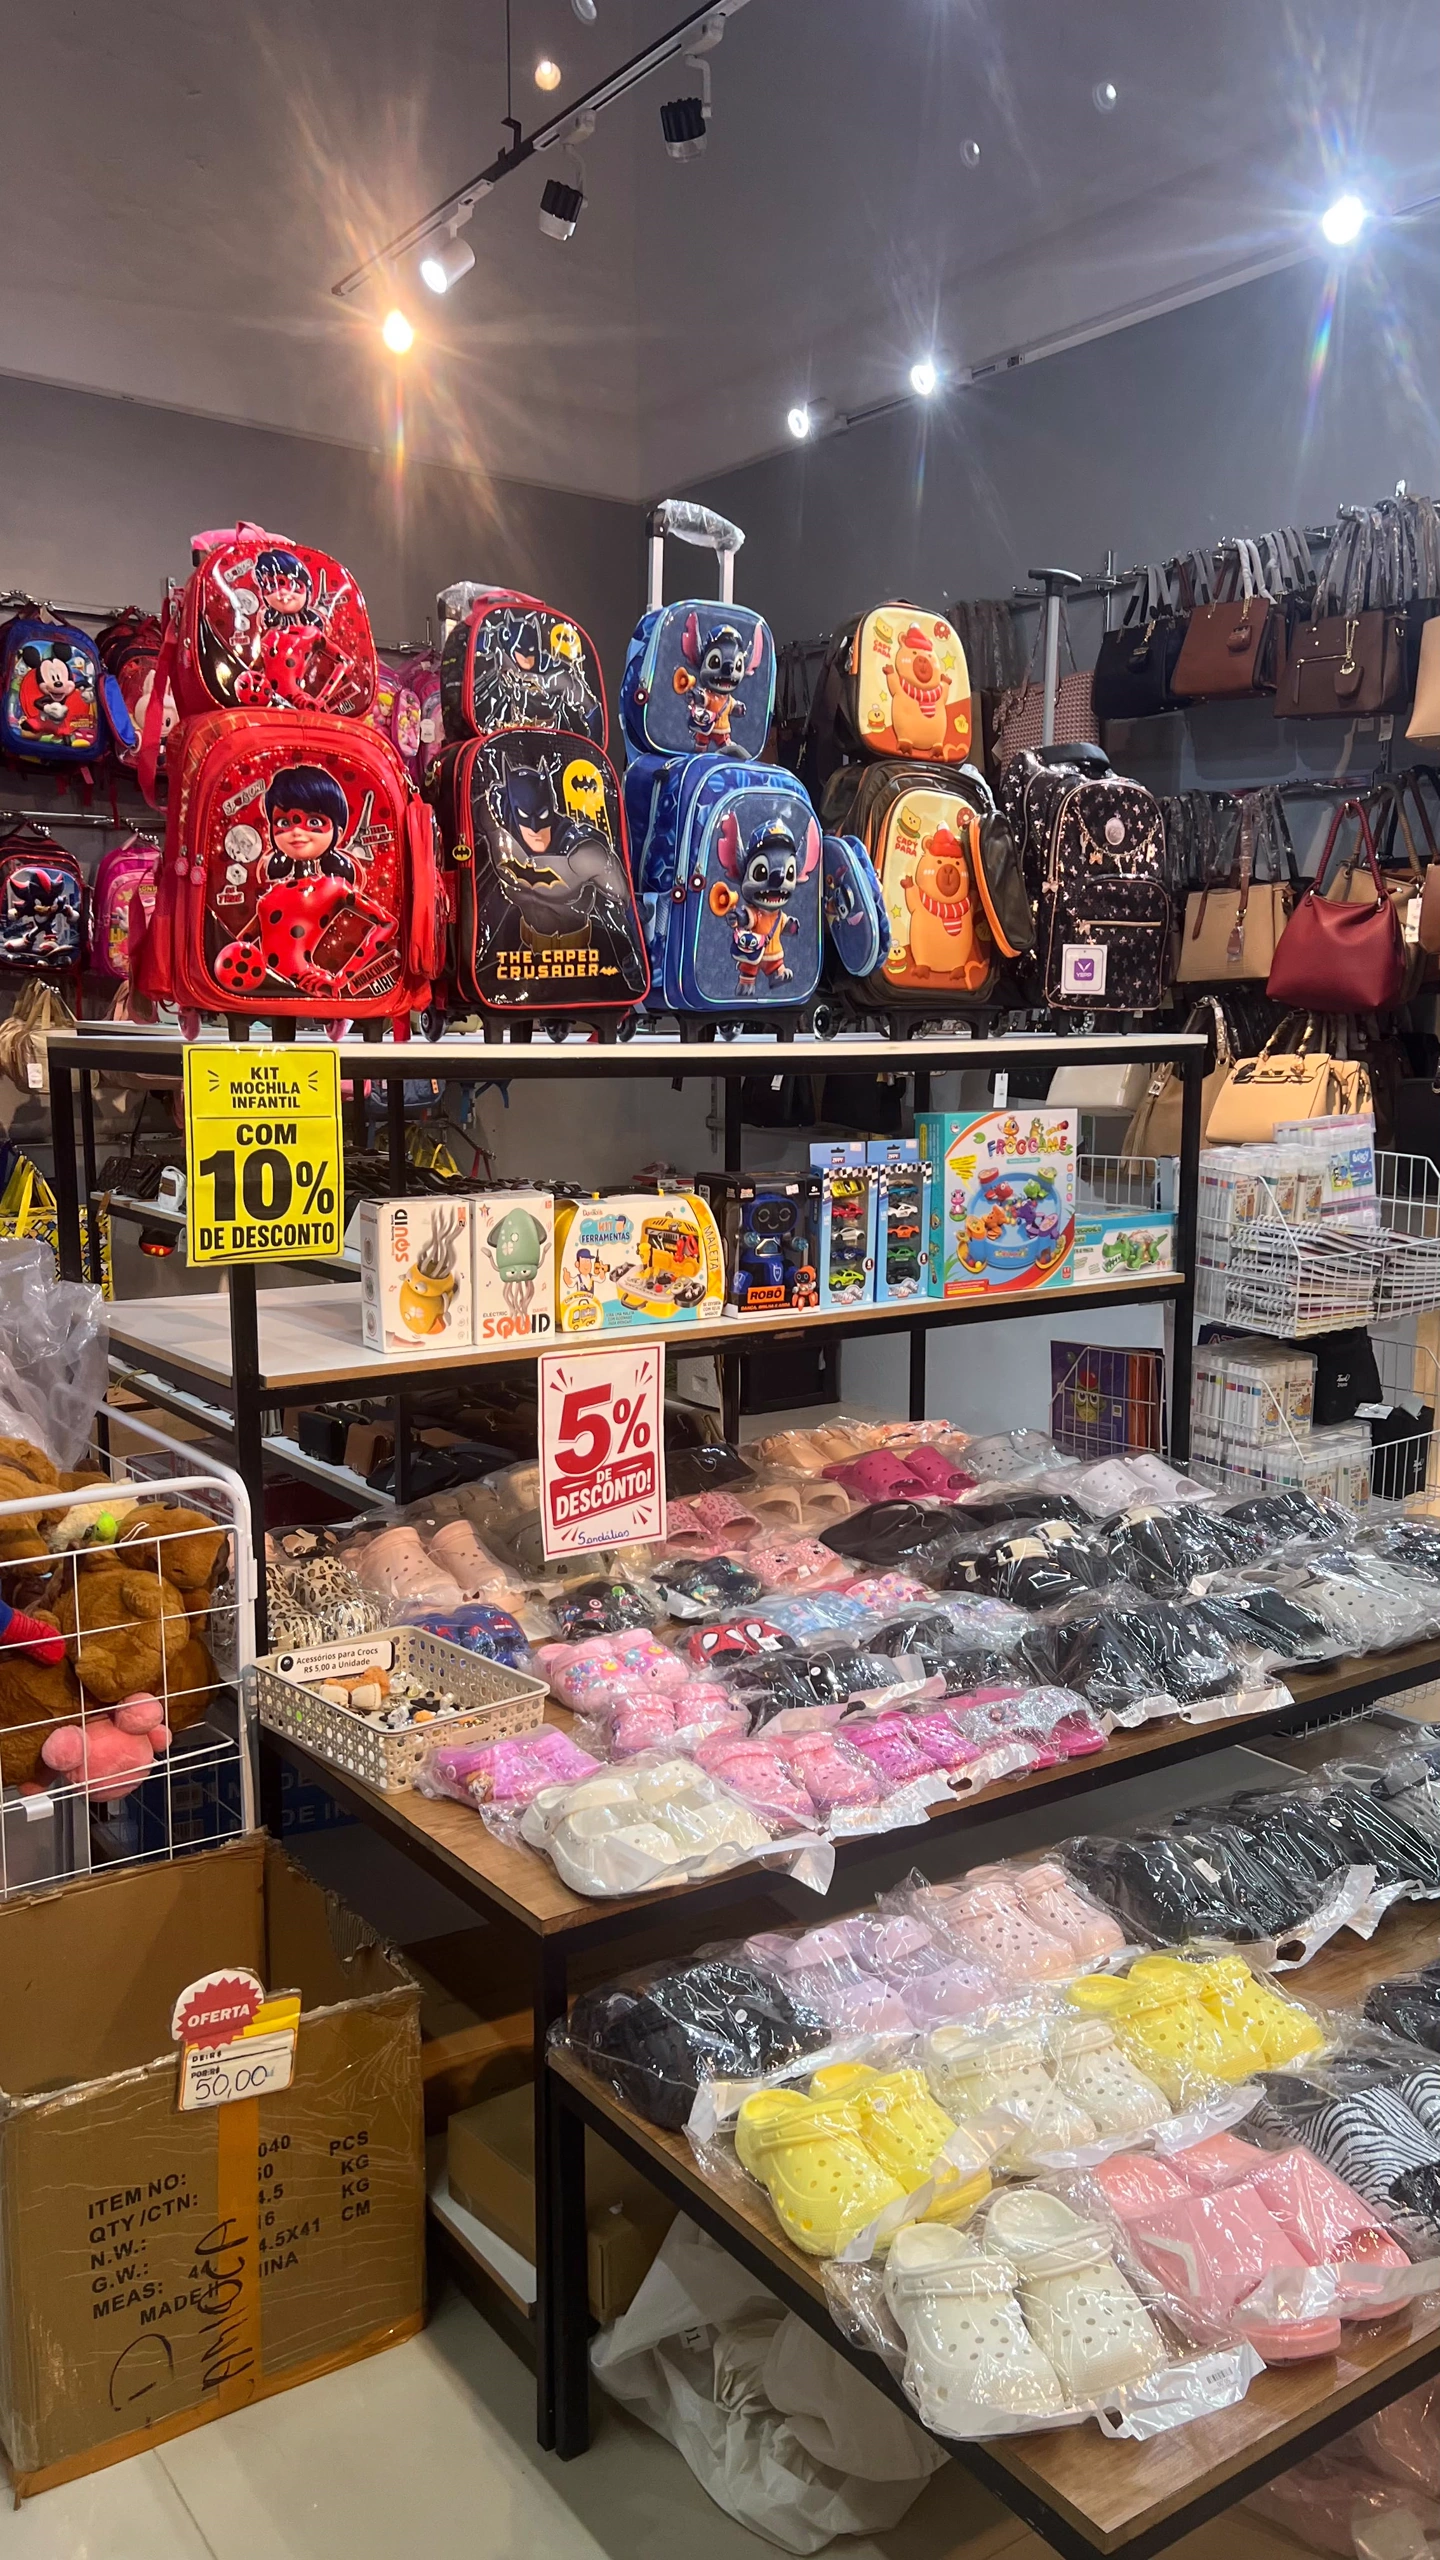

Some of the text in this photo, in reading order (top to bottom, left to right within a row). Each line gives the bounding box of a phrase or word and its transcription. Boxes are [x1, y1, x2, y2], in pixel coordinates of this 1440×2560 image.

[496, 950, 599, 964] THE CAPED
[370, 973, 397, 994] GIRL
[496, 963, 599, 980] CRUSADER
[250, 1067, 279, 1080] KIT
[230, 1081, 301, 1095] MOCHILA
[232, 1096, 301, 1109] INFANTIL
[236, 1123, 297, 1145] COM
[199, 1148, 335, 1222] 10%
[200, 1222, 335, 1251] DE DESCONTO
[394, 1208, 410, 1263] SQUID
[581, 1231, 631, 1243] FERRAMENTAS
[598, 1221, 613, 1232] KIT
[703, 1225, 719, 1271] MALETA
[750, 1286, 782, 1300] ROBÔ
[482, 1310, 508, 1318] ELECTRIC
[482, 1313, 551, 1339] SQUID
[554, 1382, 651, 1476] 5%
[596, 1467, 612, 1484] DE
[556, 1467, 652, 1522] DESCONTO!
[296, 1647, 378, 1665] Acessórios para Crocs
[304, 1665, 313, 1674] R$
[315, 1663, 330, 1673] 5,00
[338, 1658, 371, 1669] Unidade
[187, 2003, 250, 2028] OFERTA
[195, 2065, 268, 2100] 50,00
[88, 2186, 142, 2220] ITEM
[148, 2173, 187, 2198] NO:
[89, 2213, 135, 2244] QTY
[139, 2193, 198, 2228] /CTN:
[328, 2130, 369, 2156] PCS
[90, 2238, 146, 2270] N.W.:
[341, 2154, 370, 2175] KG
[91, 2262, 149, 2294] G.W.:
[341, 2178, 370, 2199] KG
[92, 2282, 163, 2319] MEAS:
[341, 2200, 371, 2222] CM
[140, 2285, 202, 2326] MADE
